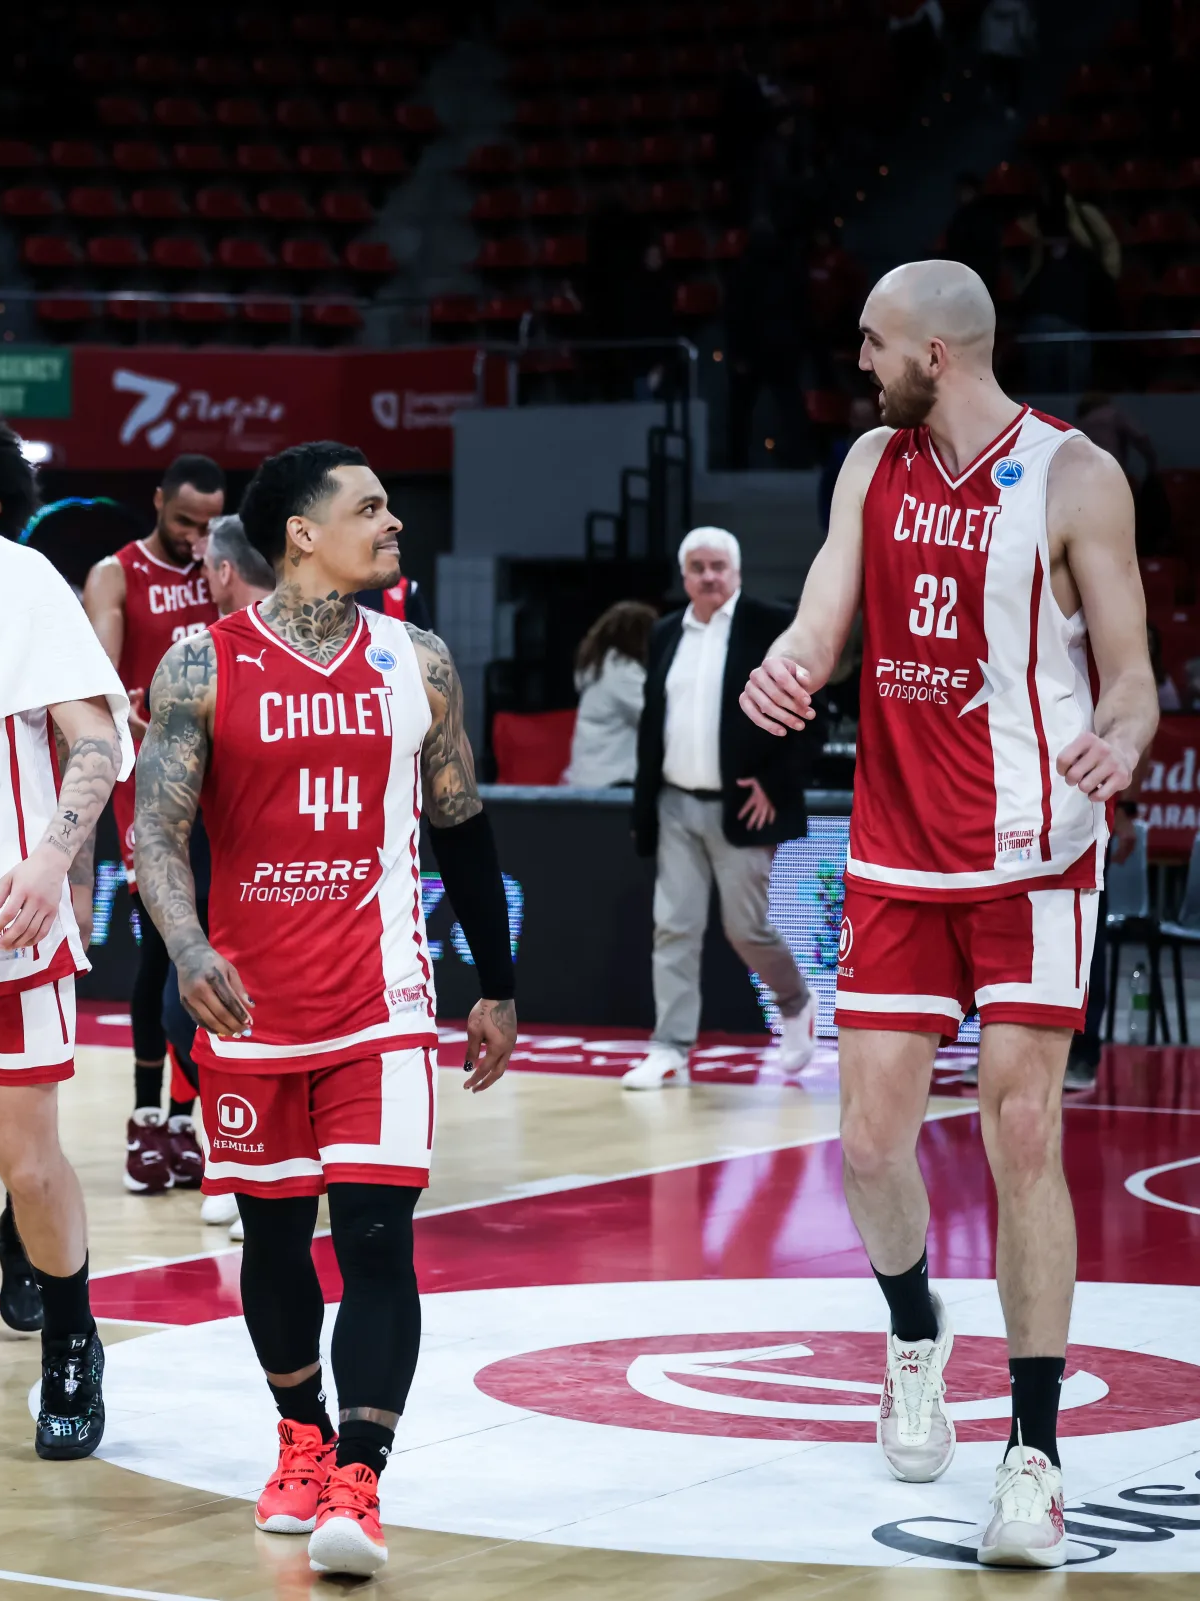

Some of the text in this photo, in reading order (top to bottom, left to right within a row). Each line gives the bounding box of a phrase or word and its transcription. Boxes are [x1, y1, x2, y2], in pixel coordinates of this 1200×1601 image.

[893, 493, 1002, 552] CHOLET
[148, 577, 209, 614] CHOLE
[908, 573, 958, 639] 32
[259, 686, 393, 743] CHOLET
[298, 766, 362, 832] 44
[239, 882, 350, 907] Transports
[213, 1137, 265, 1153] HEMILLÉ
